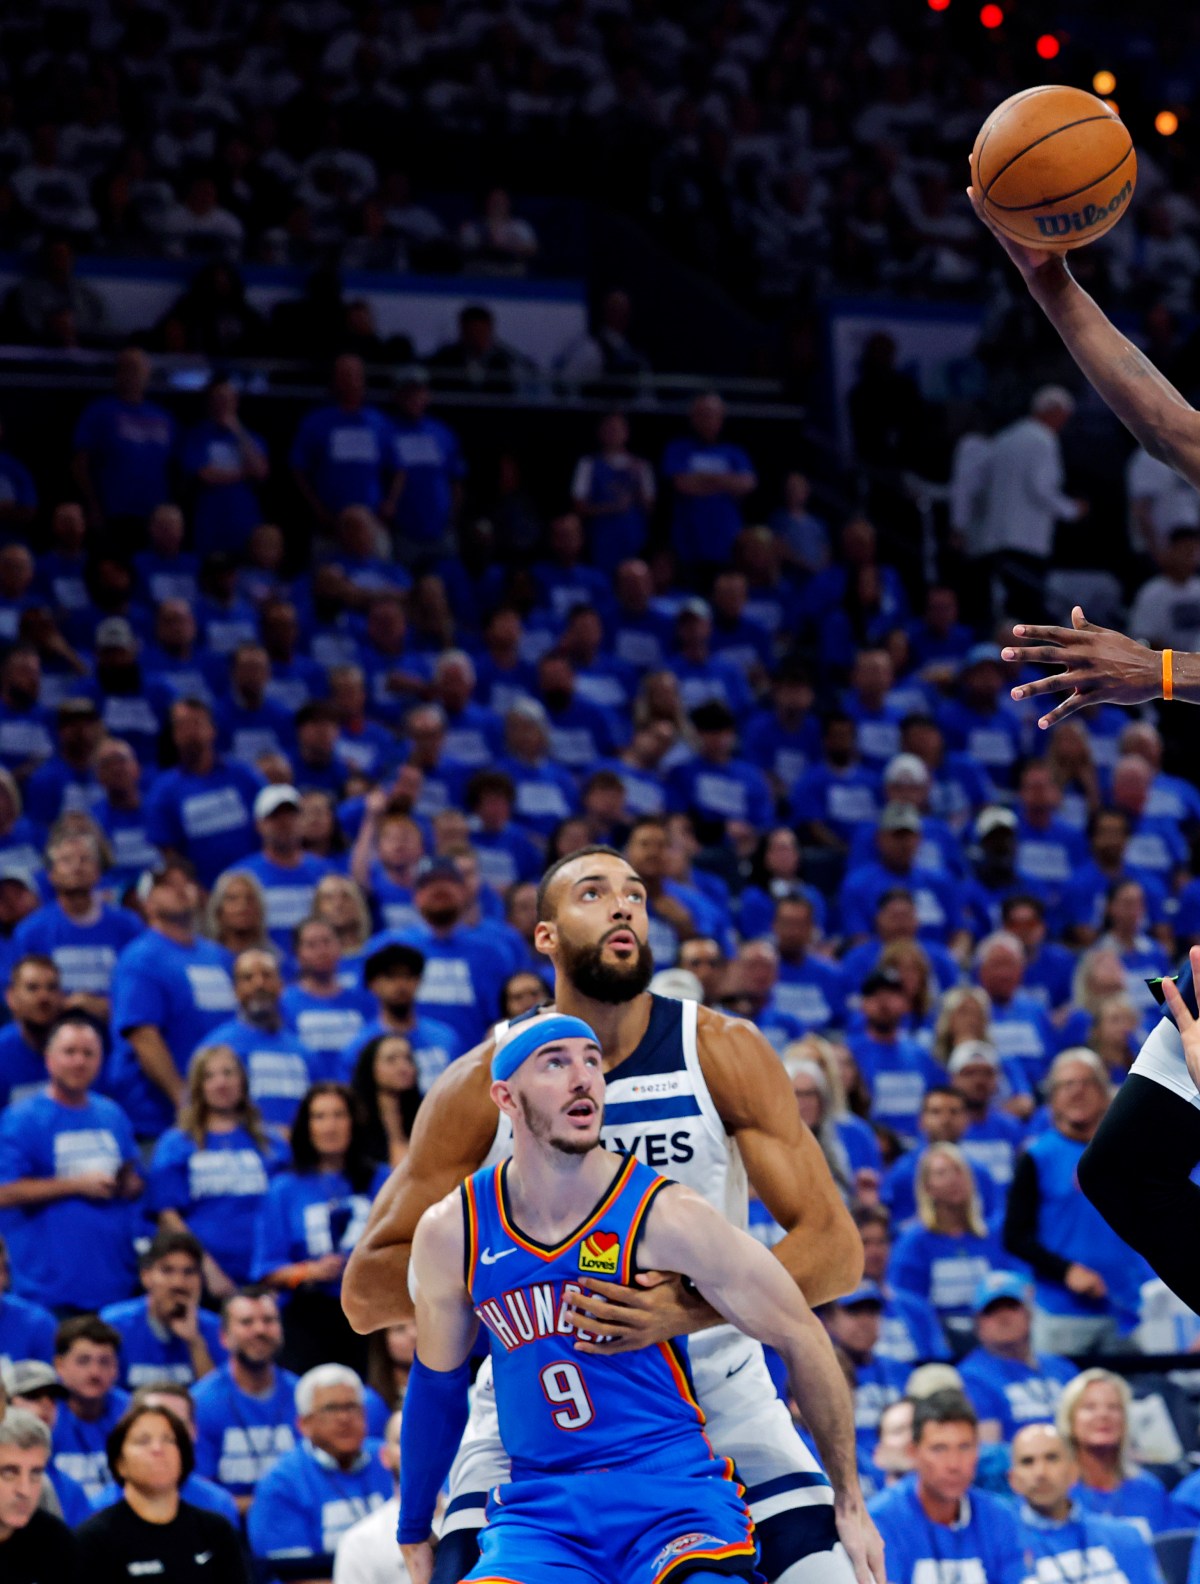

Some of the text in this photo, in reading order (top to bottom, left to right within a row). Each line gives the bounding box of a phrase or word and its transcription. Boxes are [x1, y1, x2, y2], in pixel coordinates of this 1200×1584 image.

[1034, 180, 1132, 237] Wilson
[640, 1081, 678, 1093] sezzle
[582, 1256, 615, 1271] Love's
[474, 1280, 623, 1352] THUND
[539, 1360, 596, 1431] 9
